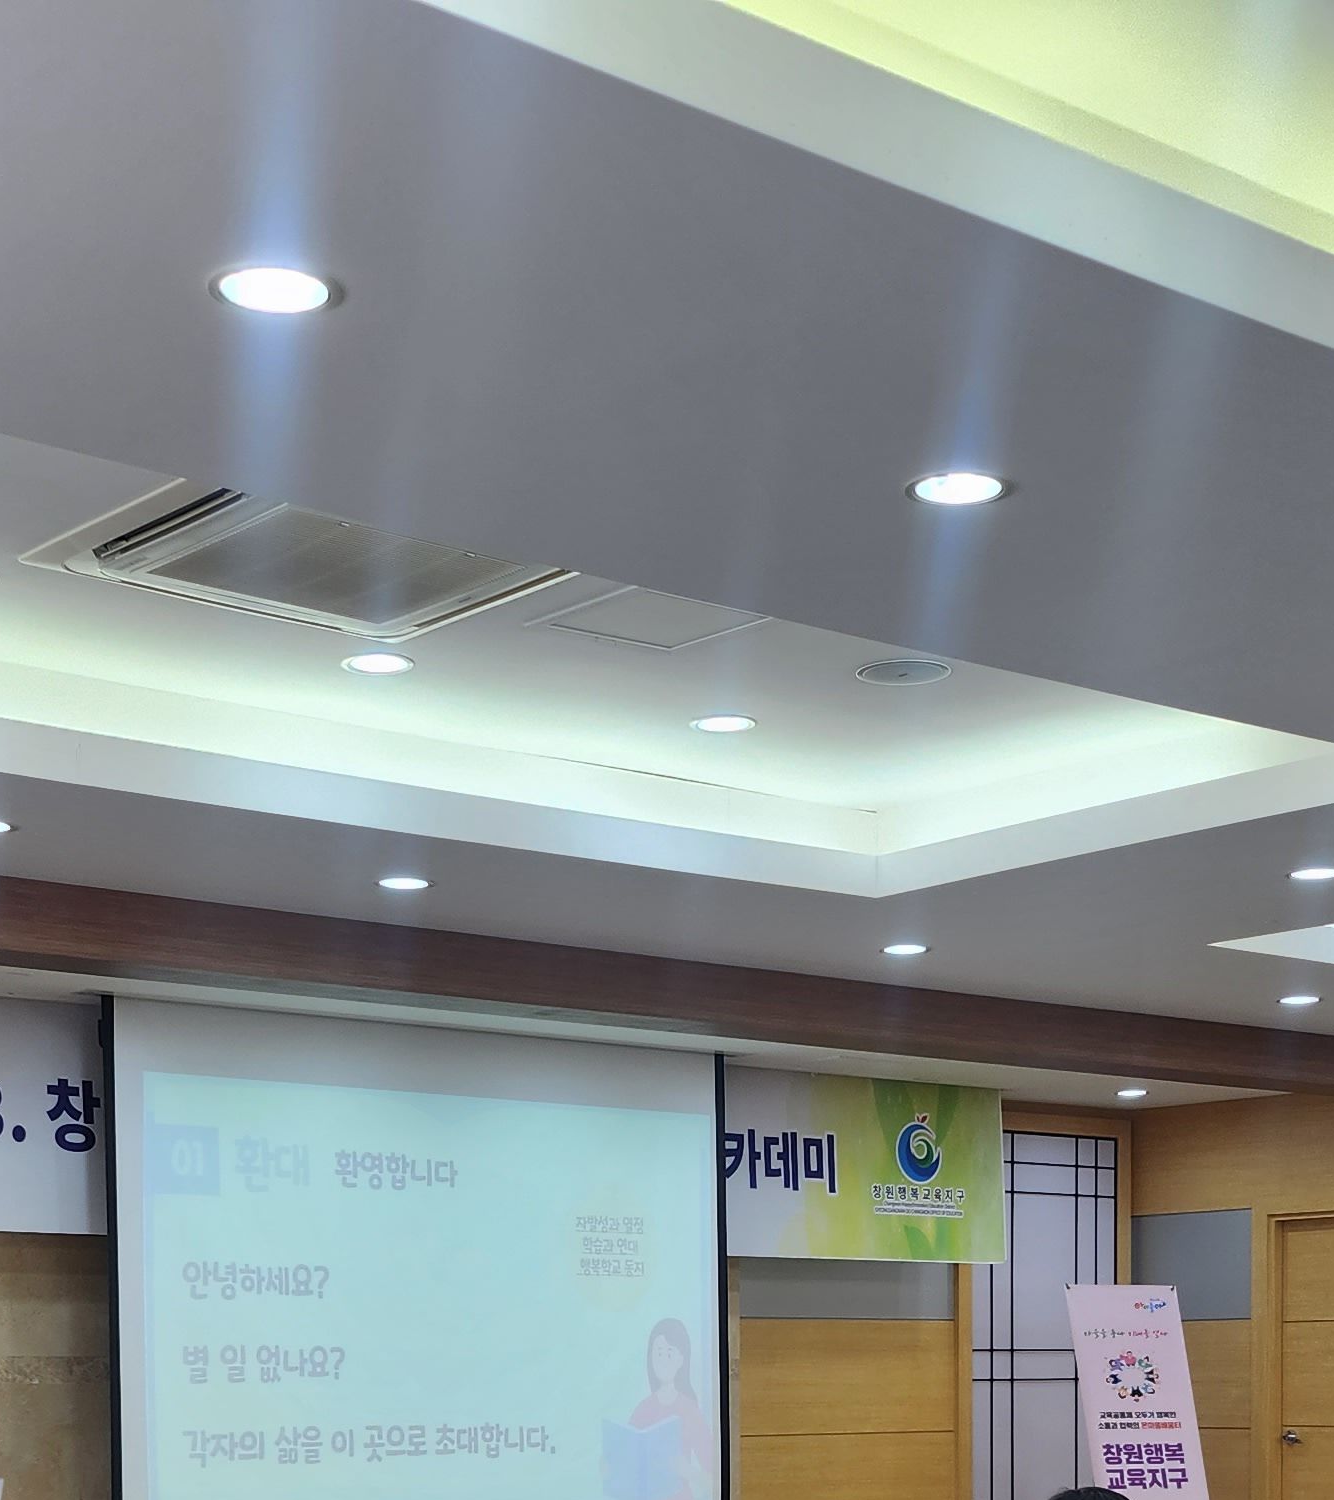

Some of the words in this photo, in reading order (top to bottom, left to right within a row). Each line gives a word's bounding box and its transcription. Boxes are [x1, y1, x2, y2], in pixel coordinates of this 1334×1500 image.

[170, 1140, 205, 1175] 01
[234, 1135, 310, 1192] 환대
[334, 1150, 458, 1190] 환영합니다
[872, 1184, 965, 1203] 창원행복교육지구
[182, 1261, 330, 1300] 안녕하세요?
[182, 1346, 208, 1384] 별
[220, 1345, 246, 1381] 일
[257, 1345, 345, 1383] 없나요?
[182, 1429, 265, 1468] 각자의
[274, 1427, 322, 1464] 삶을
[331, 1428, 354, 1457] 이
[363, 1425, 428, 1461] 곳으로
[434, 1423, 556, 1460] 초대합니다.
[1102, 1443, 1185, 1465] 창원행복
[1106, 1468, 1188, 1489] 교육지구
